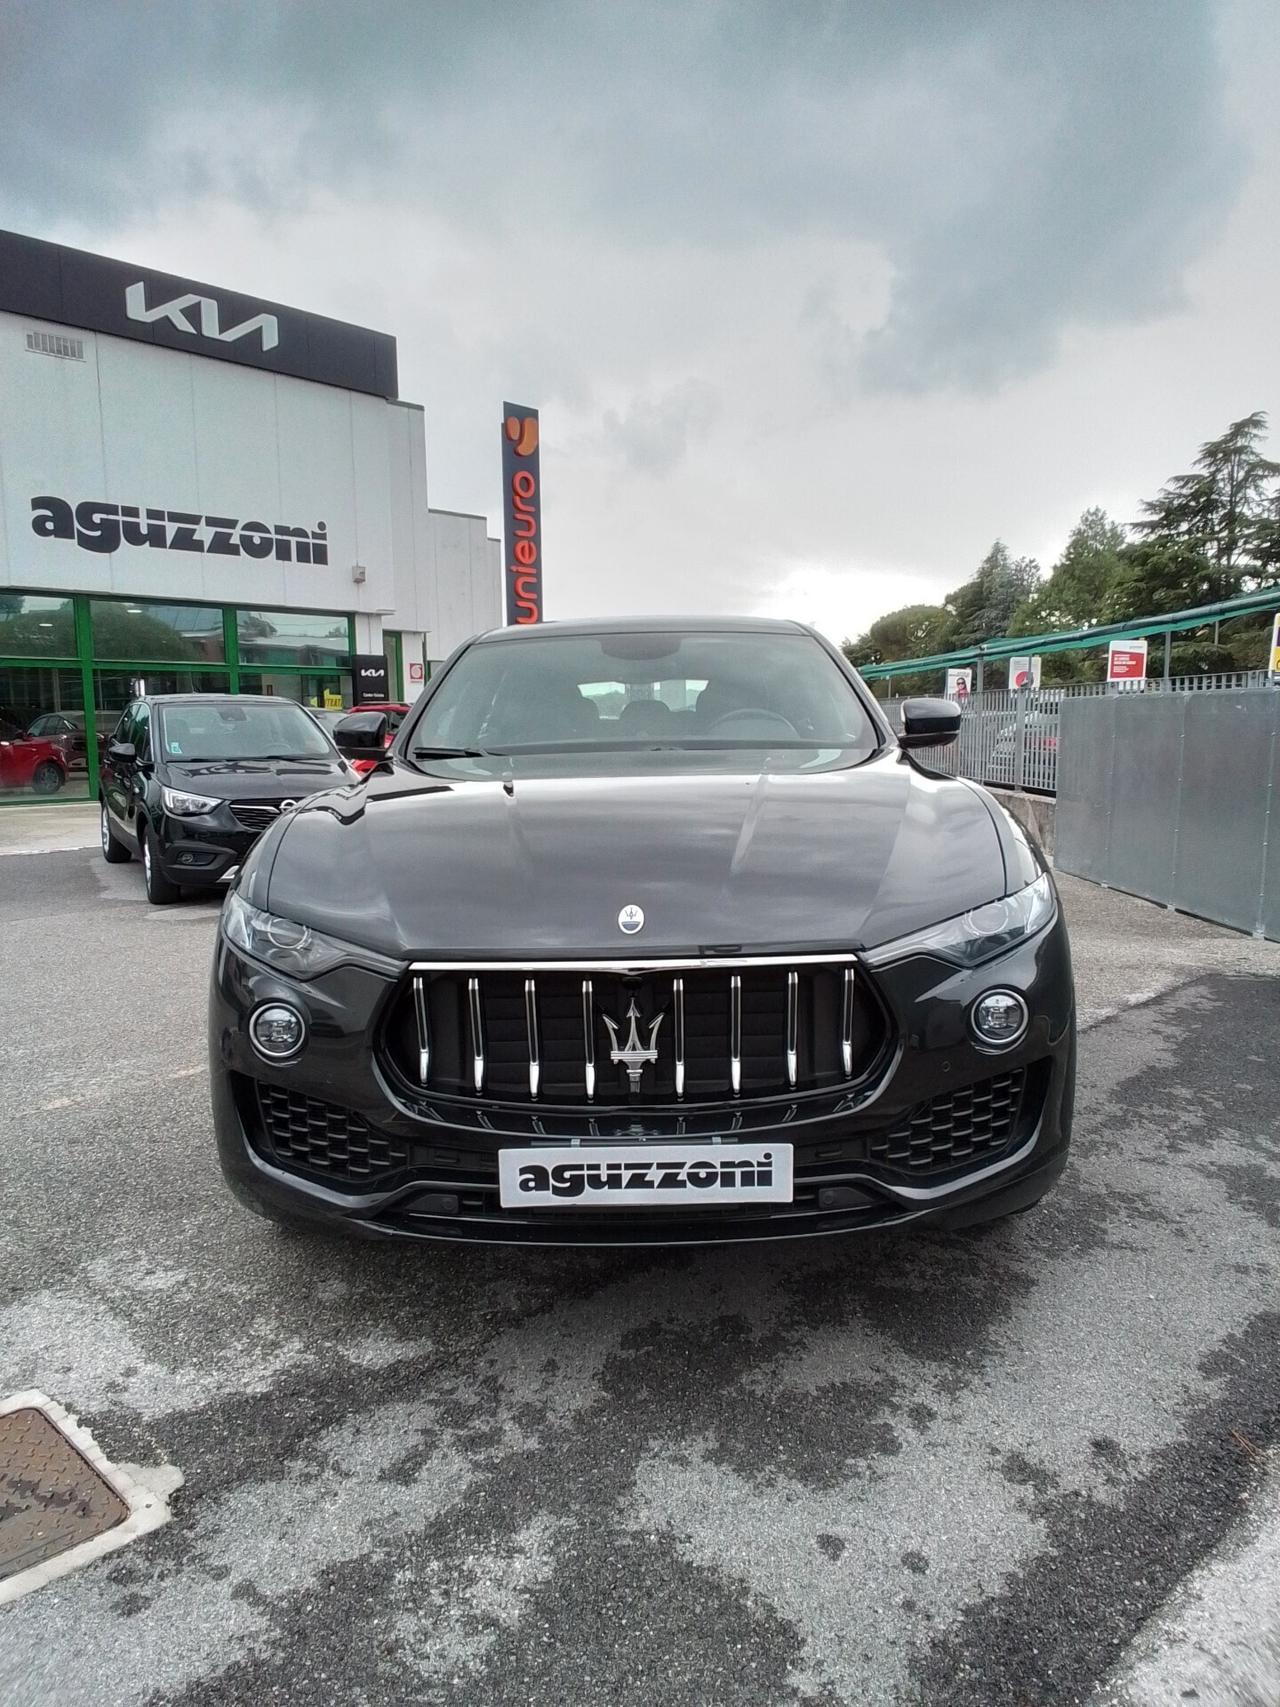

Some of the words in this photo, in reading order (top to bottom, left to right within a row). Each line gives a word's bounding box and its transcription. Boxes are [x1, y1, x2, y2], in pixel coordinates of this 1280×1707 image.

[31, 495, 328, 566] aguzzoni
[510, 470, 539, 624] unieuro
[518, 1152, 773, 1198] aguzzoni
